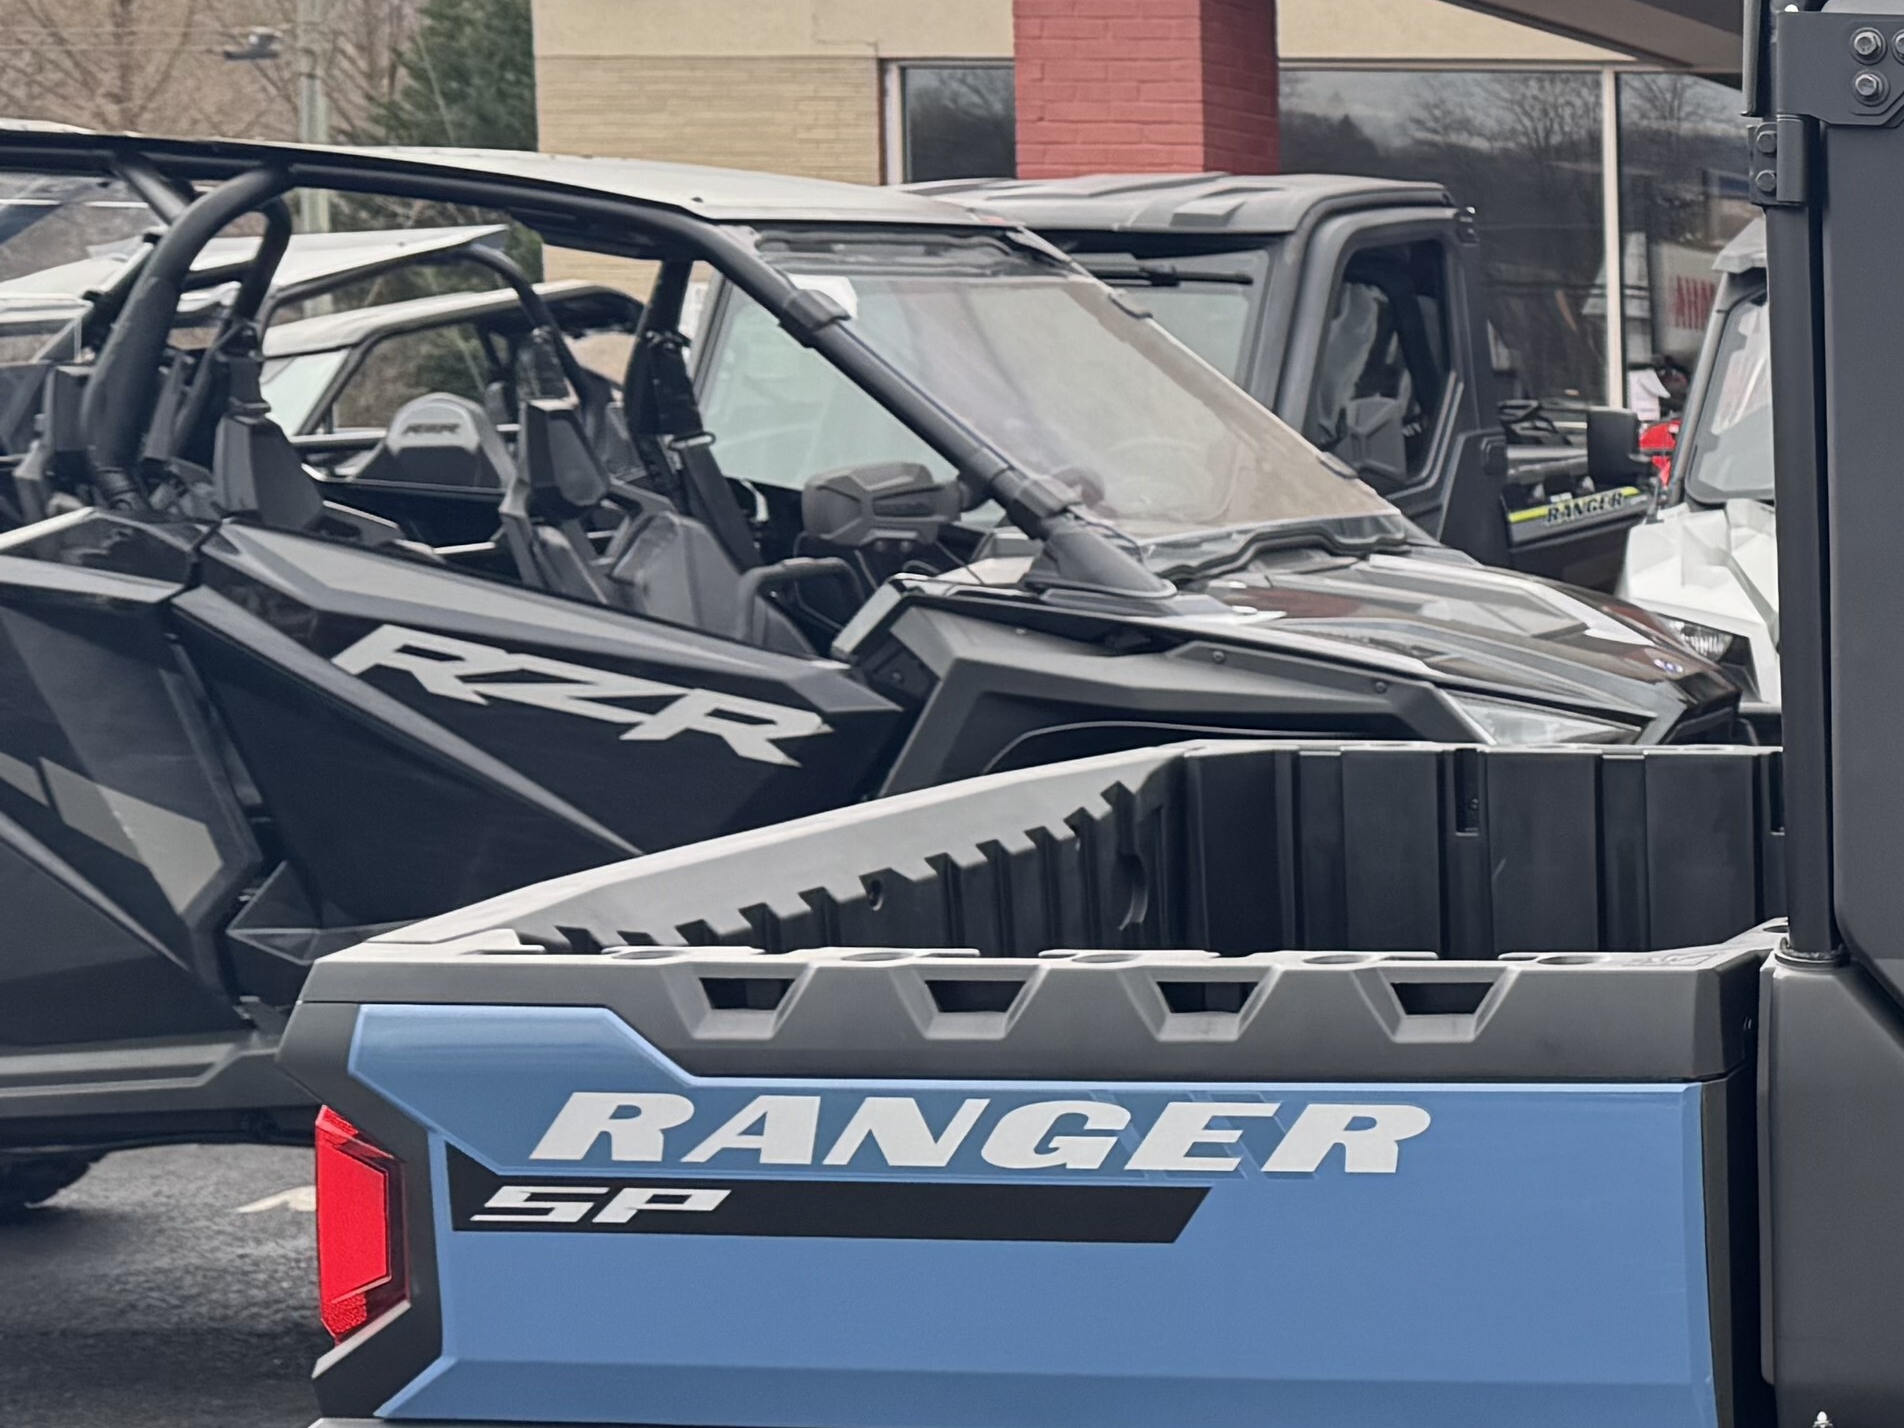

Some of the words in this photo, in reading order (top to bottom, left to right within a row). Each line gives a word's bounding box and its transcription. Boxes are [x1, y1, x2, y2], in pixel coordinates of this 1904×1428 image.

[331, 624, 834, 768] RZR
[529, 1091, 1432, 1174] RANGER
[471, 1186, 731, 1224] SP
